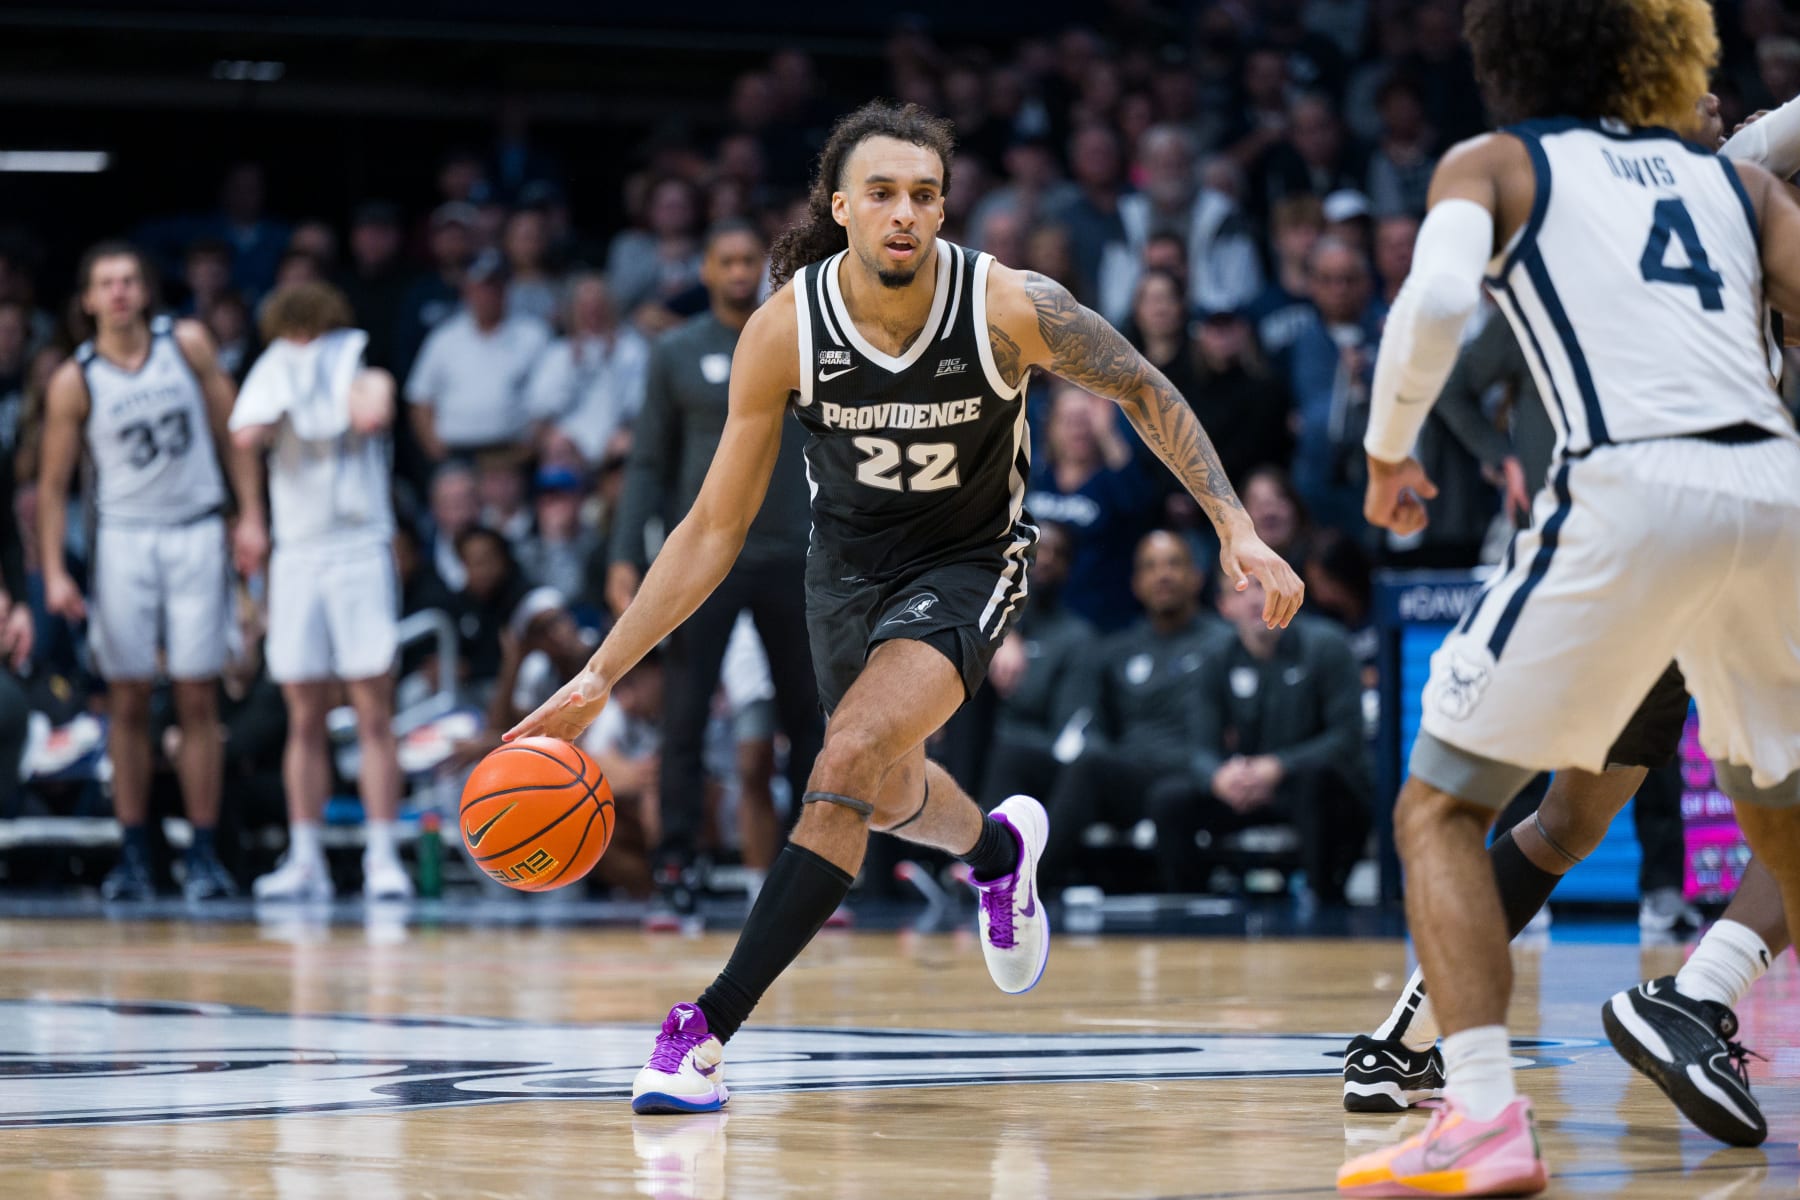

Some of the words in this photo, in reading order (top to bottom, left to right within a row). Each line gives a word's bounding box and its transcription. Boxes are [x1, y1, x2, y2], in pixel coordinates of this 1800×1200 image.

[1639, 196, 1725, 311] 4
[936, 364, 968, 373] EAST
[939, 358, 961, 366] BIG
[820, 396, 983, 430] PROVIDENCE
[119, 406, 192, 470] 33
[852, 436, 961, 493] 22
